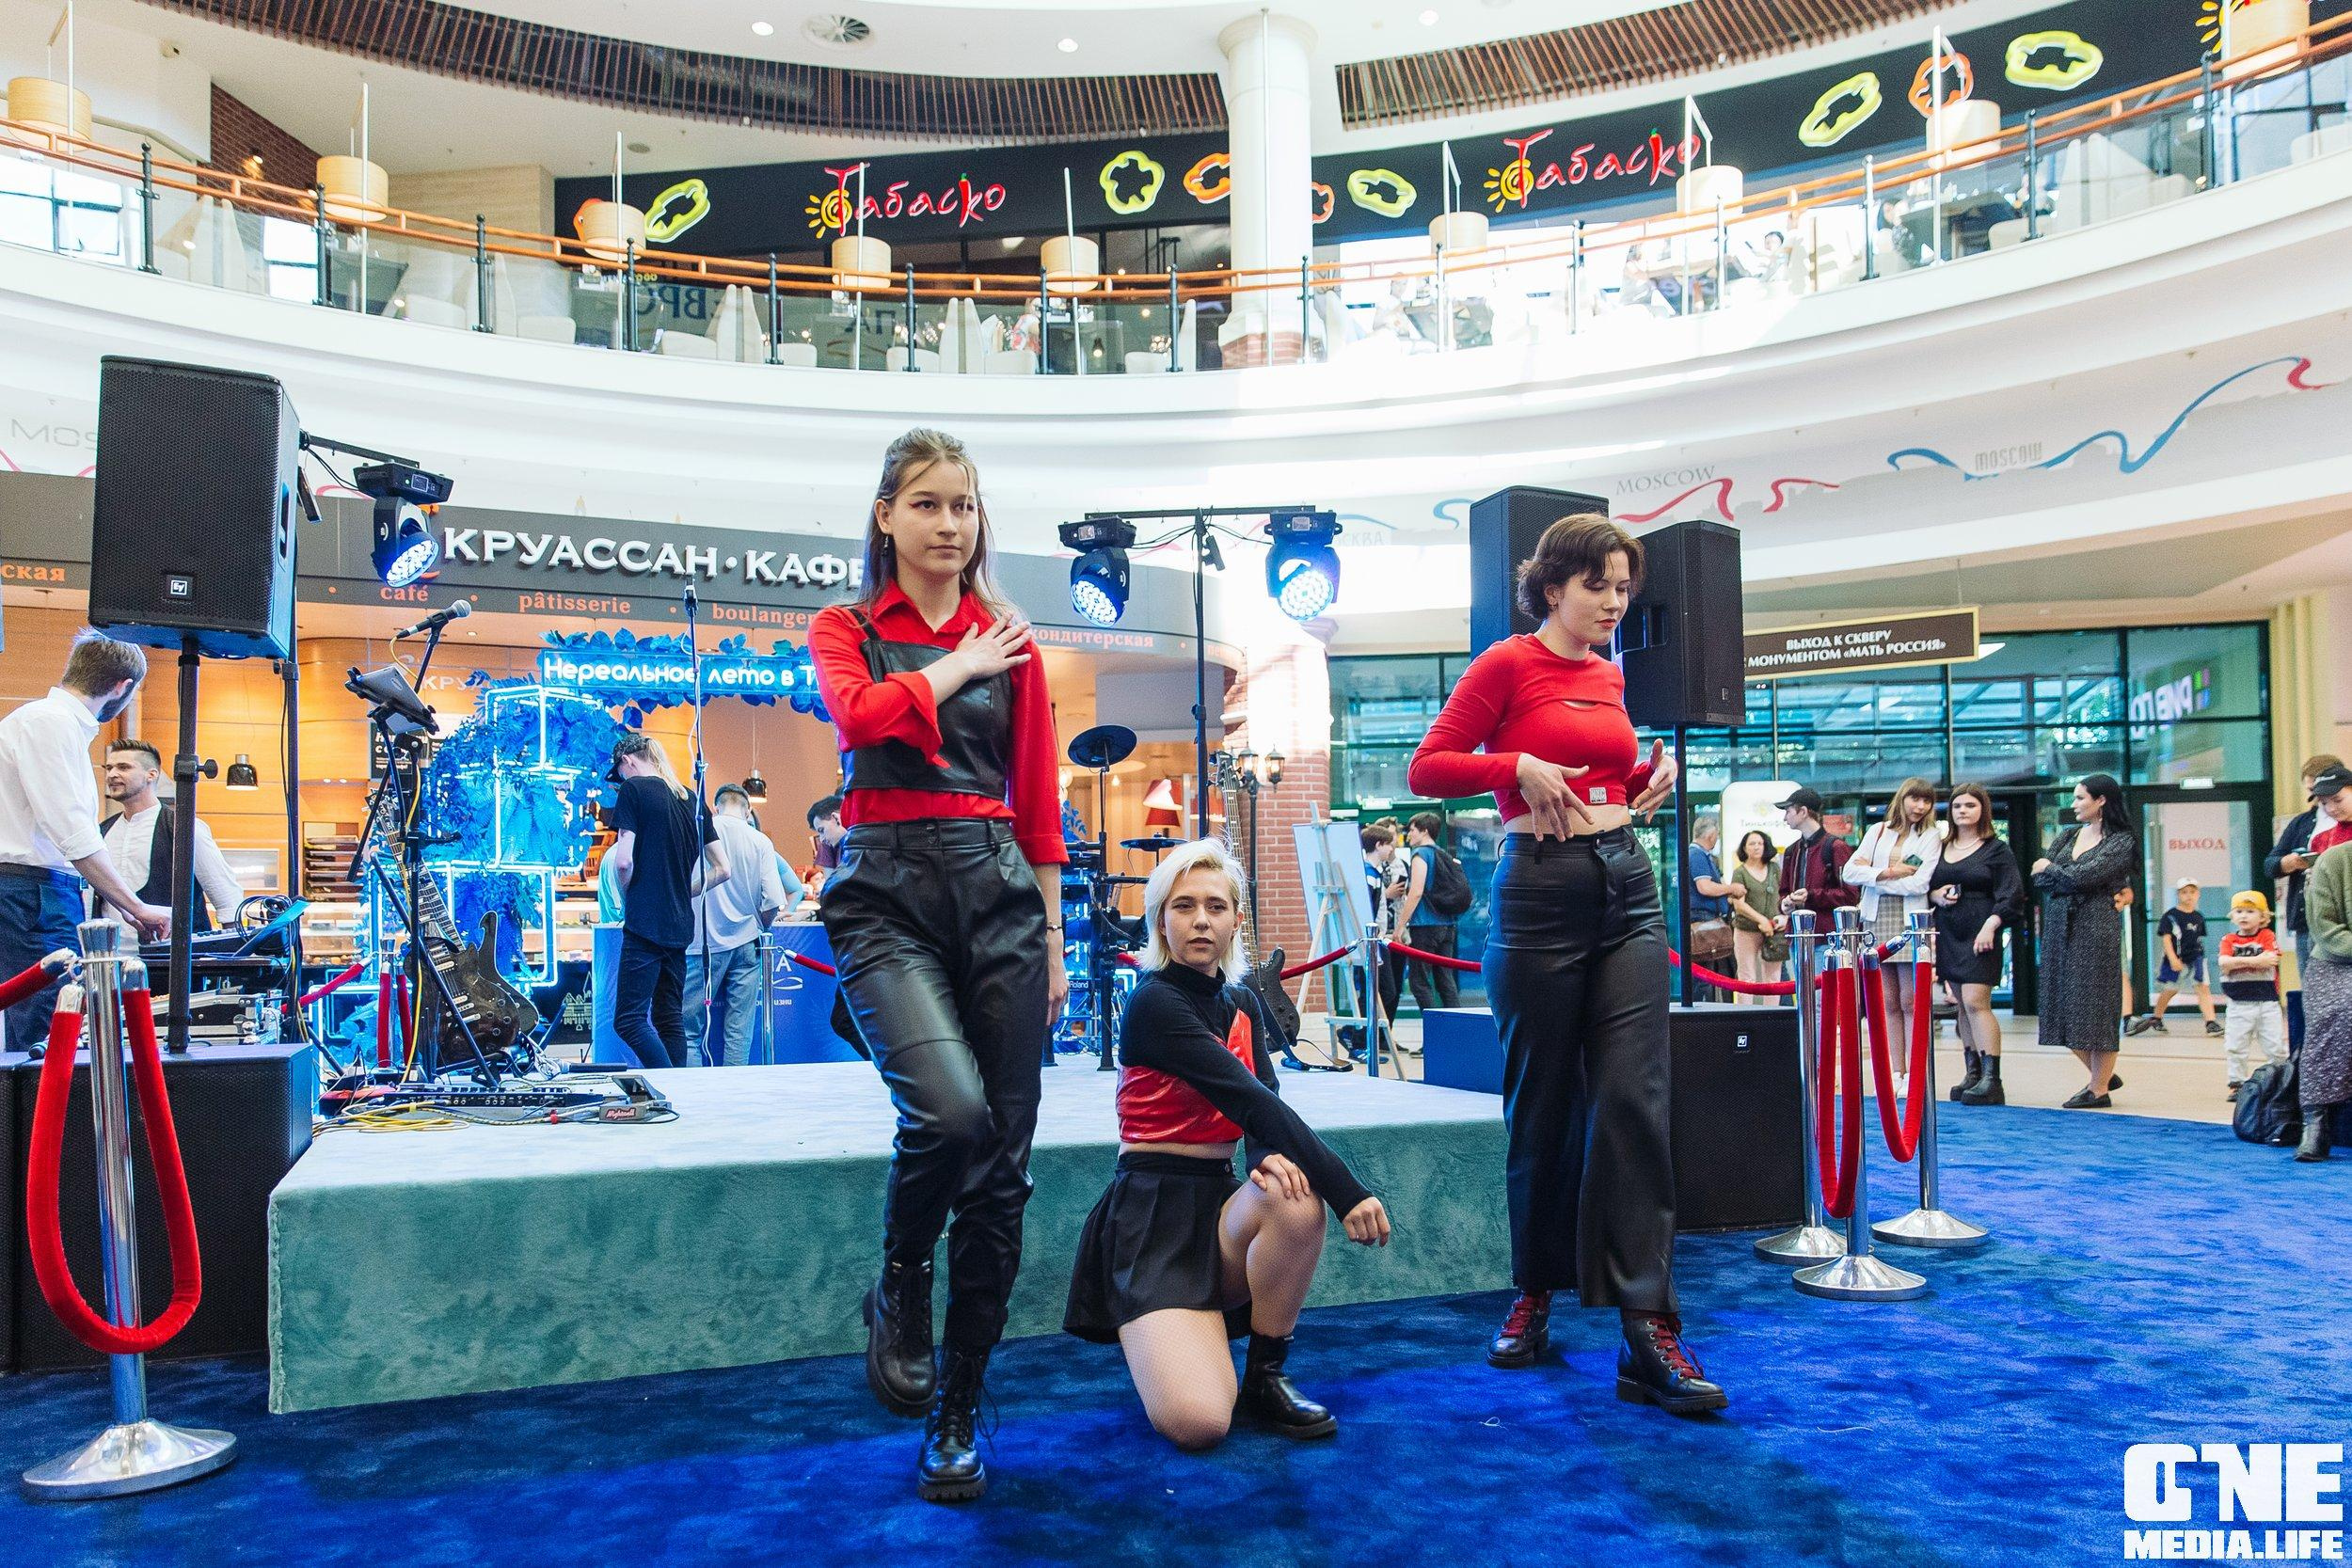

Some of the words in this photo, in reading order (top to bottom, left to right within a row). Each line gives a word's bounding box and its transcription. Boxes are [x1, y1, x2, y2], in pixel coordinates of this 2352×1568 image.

[1503, 128, 1701, 209] Табаско
[824, 162, 1007, 237] Табаско
[1615, 466, 1716, 496] MOSCOW
[443, 527, 718, 578] КРУАССАН
[380, 584, 429, 602] café
[518, 592, 631, 613] pâtisserie
[1787, 635, 1832, 651] ВЫХОД
[1834, 633, 1844, 646] К
[1845, 629, 1892, 645] СКВЕРУ
[544, 657, 697, 686] Нереальное
[707, 666, 775, 686] лето
[781, 666, 795, 687] в
[1748, 648, 1841, 668] МОНУМЕНТОМ
[2169, 837, 2226, 850] ВЫХОД
